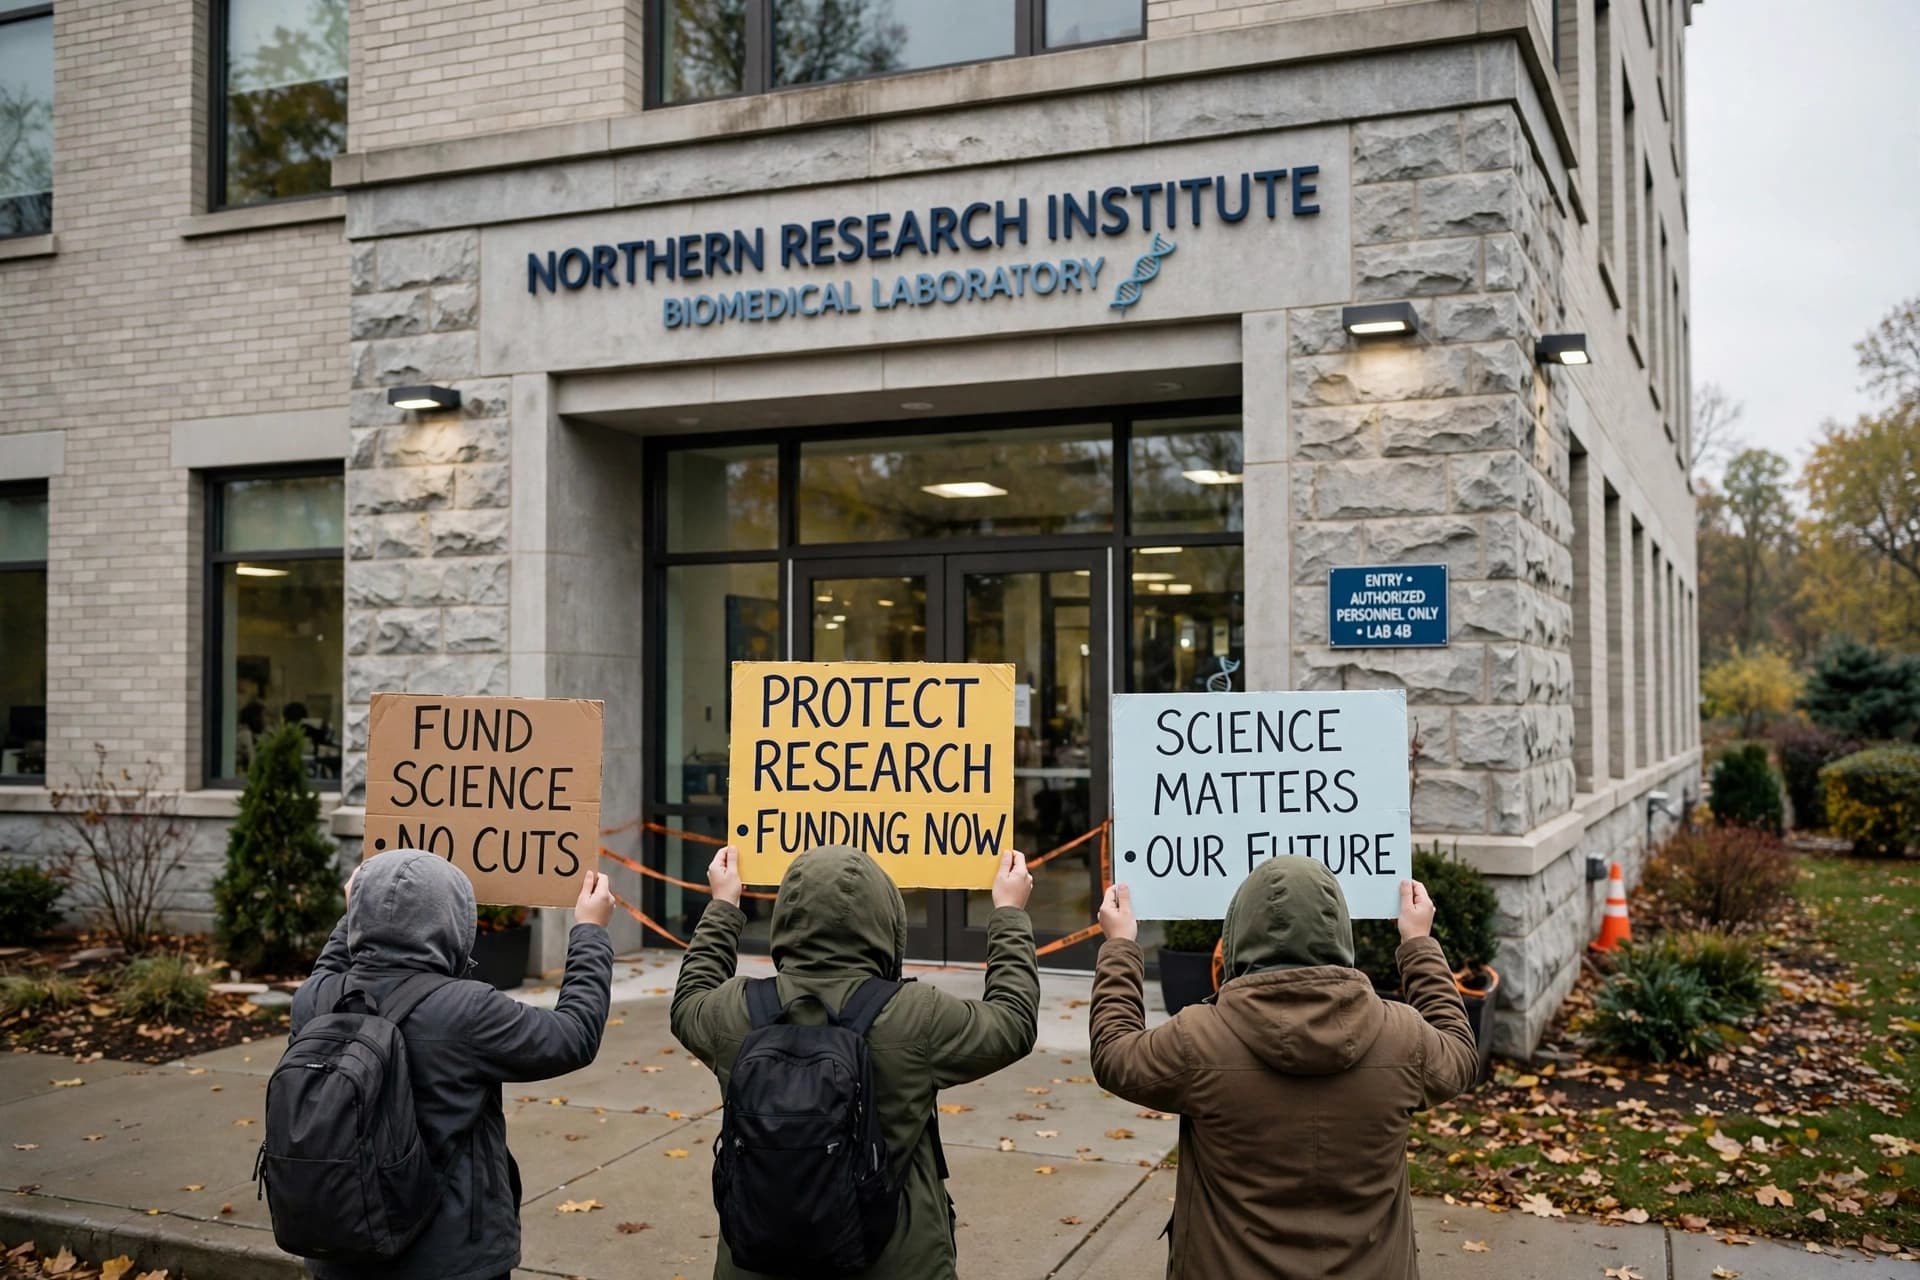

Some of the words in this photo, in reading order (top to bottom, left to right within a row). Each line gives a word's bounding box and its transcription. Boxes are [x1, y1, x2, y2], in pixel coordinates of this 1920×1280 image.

[527, 227, 764, 295] NORTHERN
[781, 198, 1027, 268] RESEARCH
[1048, 165, 1320, 241] INSTITUTE
[662, 280, 861, 328] BIOMEDICAL
[871, 256, 1105, 310] LABORATORY
[1350, 590, 1426, 605] AUTHORIZED
[1365, 573, 1403, 587] ENTRY
[1336, 607, 1405, 622] PERSONNEL
[1407, 607, 1439, 620] ONLY
[1367, 624, 1391, 638] LAB
[1394, 624, 1412, 638] 4B
[762, 675, 979, 728] PROTECT
[414, 705, 532, 752] FUND
[1156, 709, 1342, 756] SCIENCE
[390, 760, 573, 811] SCIENCE
[754, 740, 991, 793] RESEARCH
[1154, 769, 1358, 816] MATTERS
[398, 823, 454, 862] NO
[473, 827, 579, 877] CUTS
[757, 809, 910, 855] FUNDING
[924, 812, 1007, 856] NOW
[1146, 835, 1227, 878] OUR
